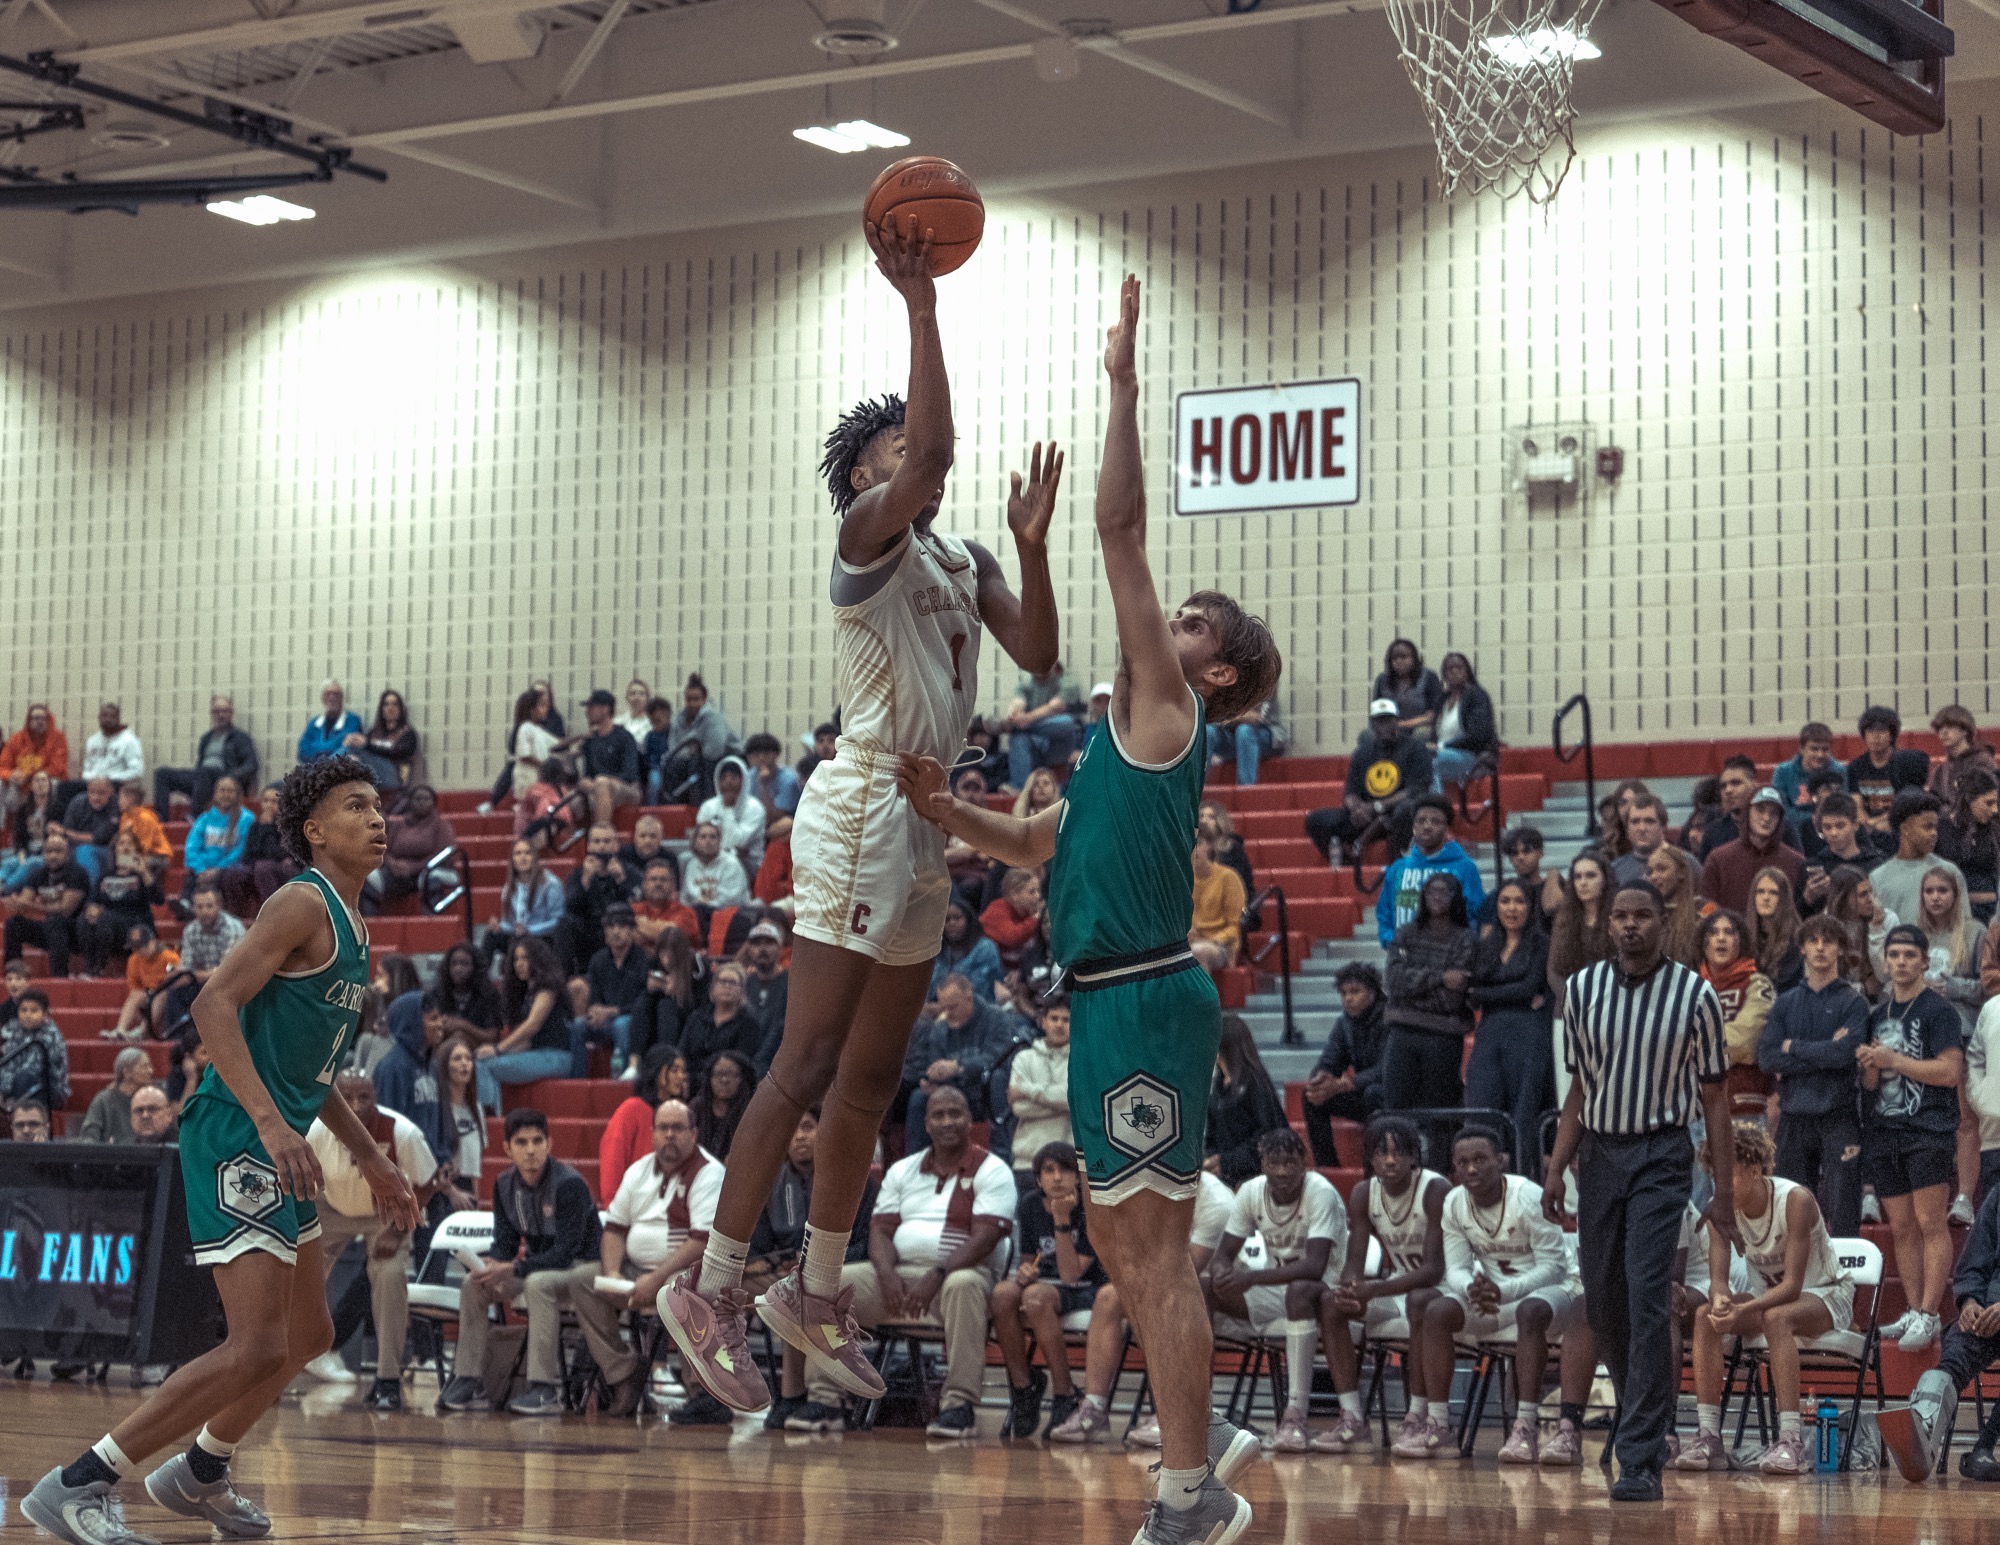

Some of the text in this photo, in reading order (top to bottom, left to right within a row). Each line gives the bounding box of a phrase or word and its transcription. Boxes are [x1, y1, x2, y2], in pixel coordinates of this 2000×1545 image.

[1190, 407, 1345, 487] HOME
[950, 632, 967, 691] 1
[851, 903, 871, 935] C
[314, 1022, 348, 1086] 2
[0, 1231, 134, 1285] L FANS
[1839, 1256, 1866, 1268] ERS
